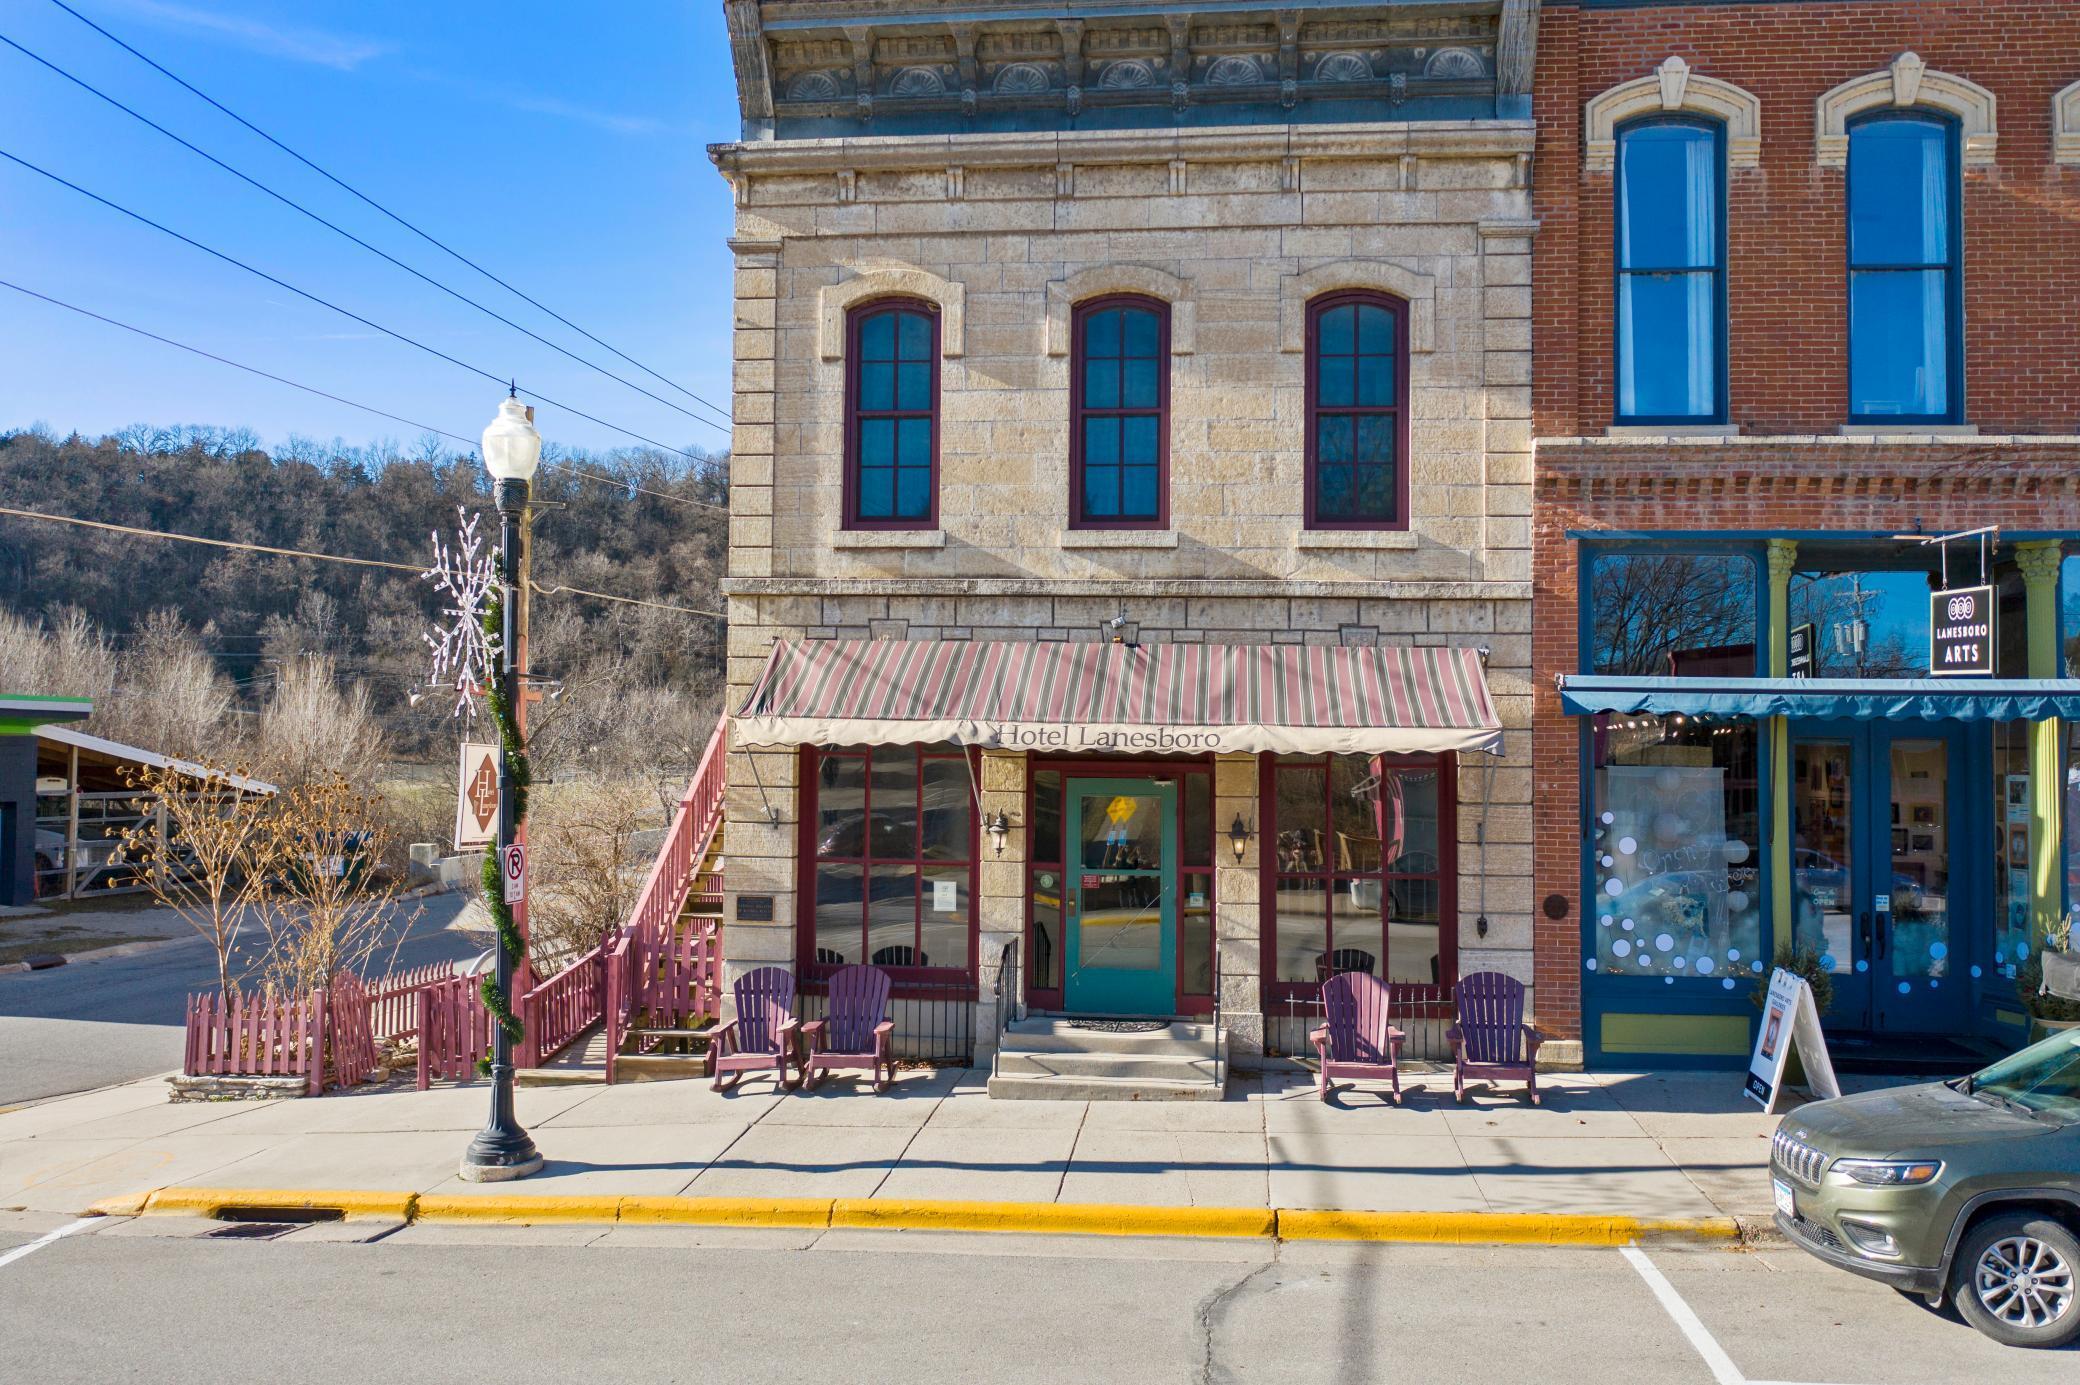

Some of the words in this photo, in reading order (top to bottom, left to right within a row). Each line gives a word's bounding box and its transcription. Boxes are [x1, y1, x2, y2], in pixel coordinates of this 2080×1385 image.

[1936, 624, 1987, 639] LANESBORO
[1945, 644, 1979, 663] ARTS
[997, 724, 1069, 746] Hotel
[1079, 726, 1221, 748] Lanesboro
[1752, 1080, 1765, 1096] OPEN
